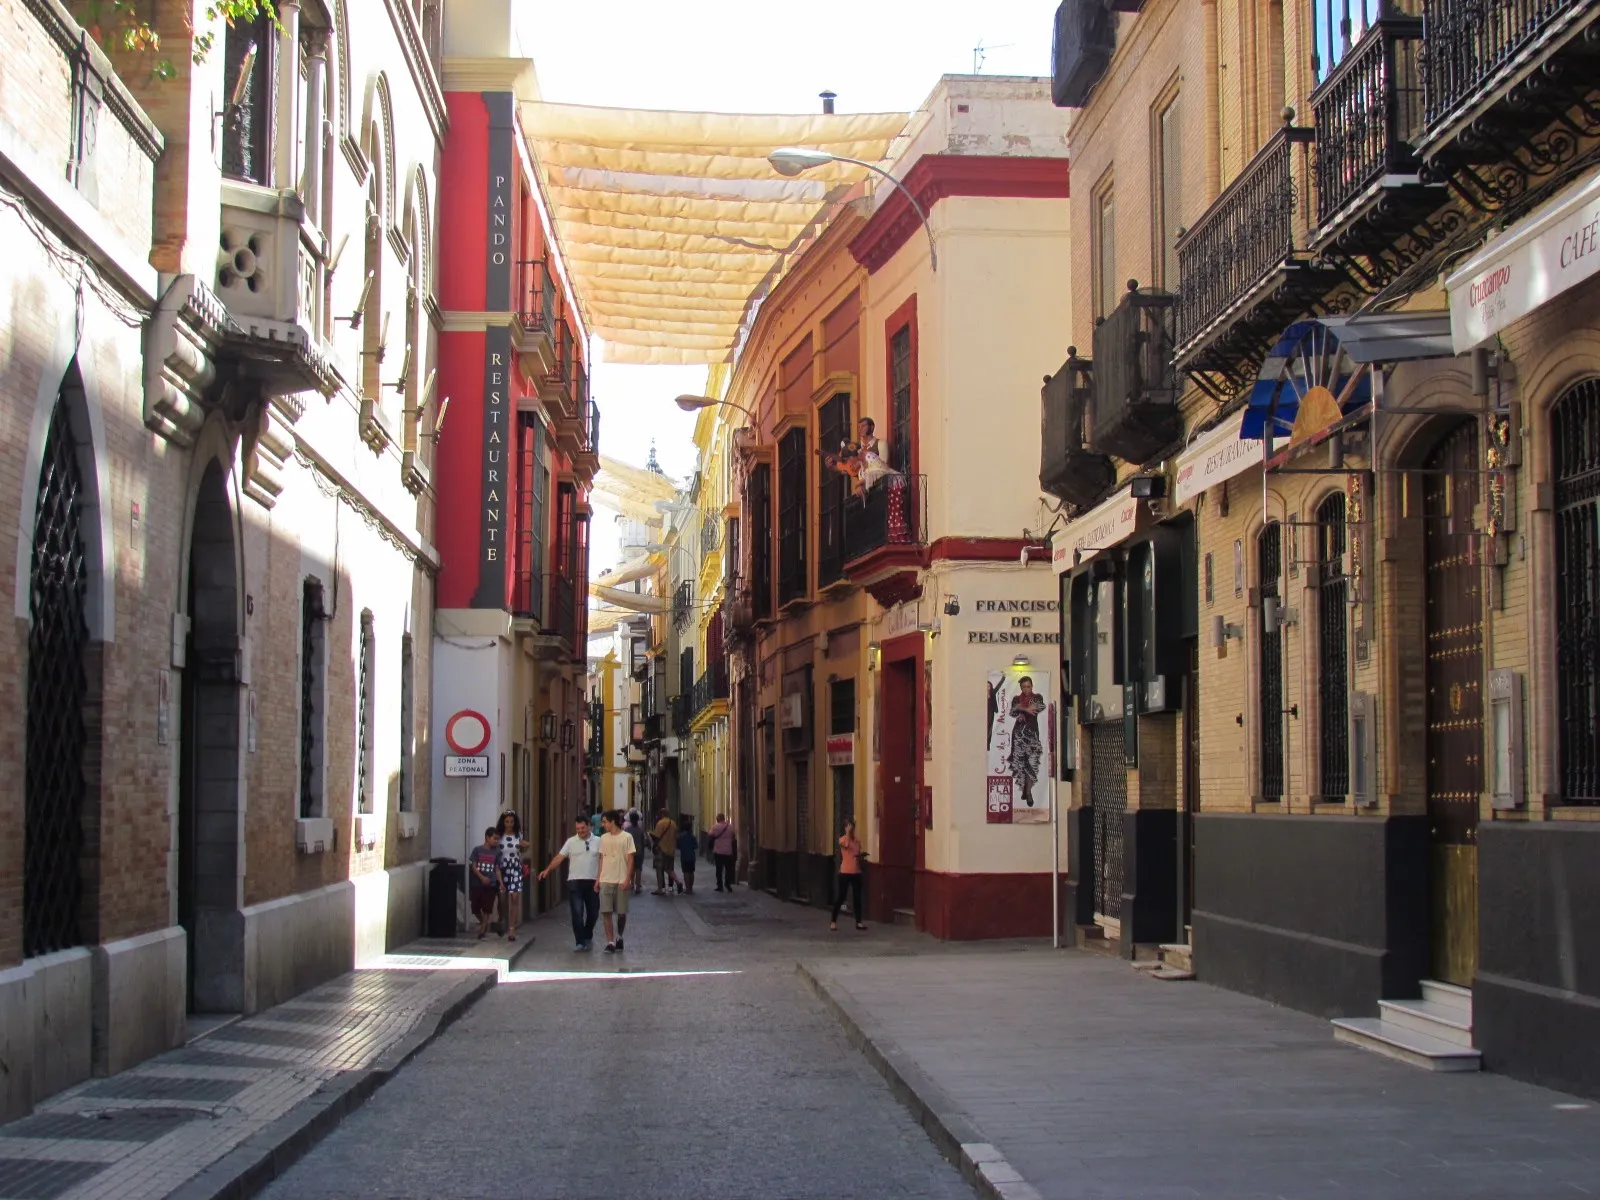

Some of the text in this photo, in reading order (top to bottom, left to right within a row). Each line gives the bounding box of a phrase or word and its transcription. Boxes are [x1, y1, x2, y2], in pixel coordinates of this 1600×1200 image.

[492, 175, 505, 265] PANDO
[1560, 211, 1599, 269] CAFÉ
[1469, 264, 1511, 308] Cruzcampo
[487, 353, 503, 561] RESTAURANTE
[976, 600, 1060, 611] FRANCISC
[1011, 616, 1031, 628] DE
